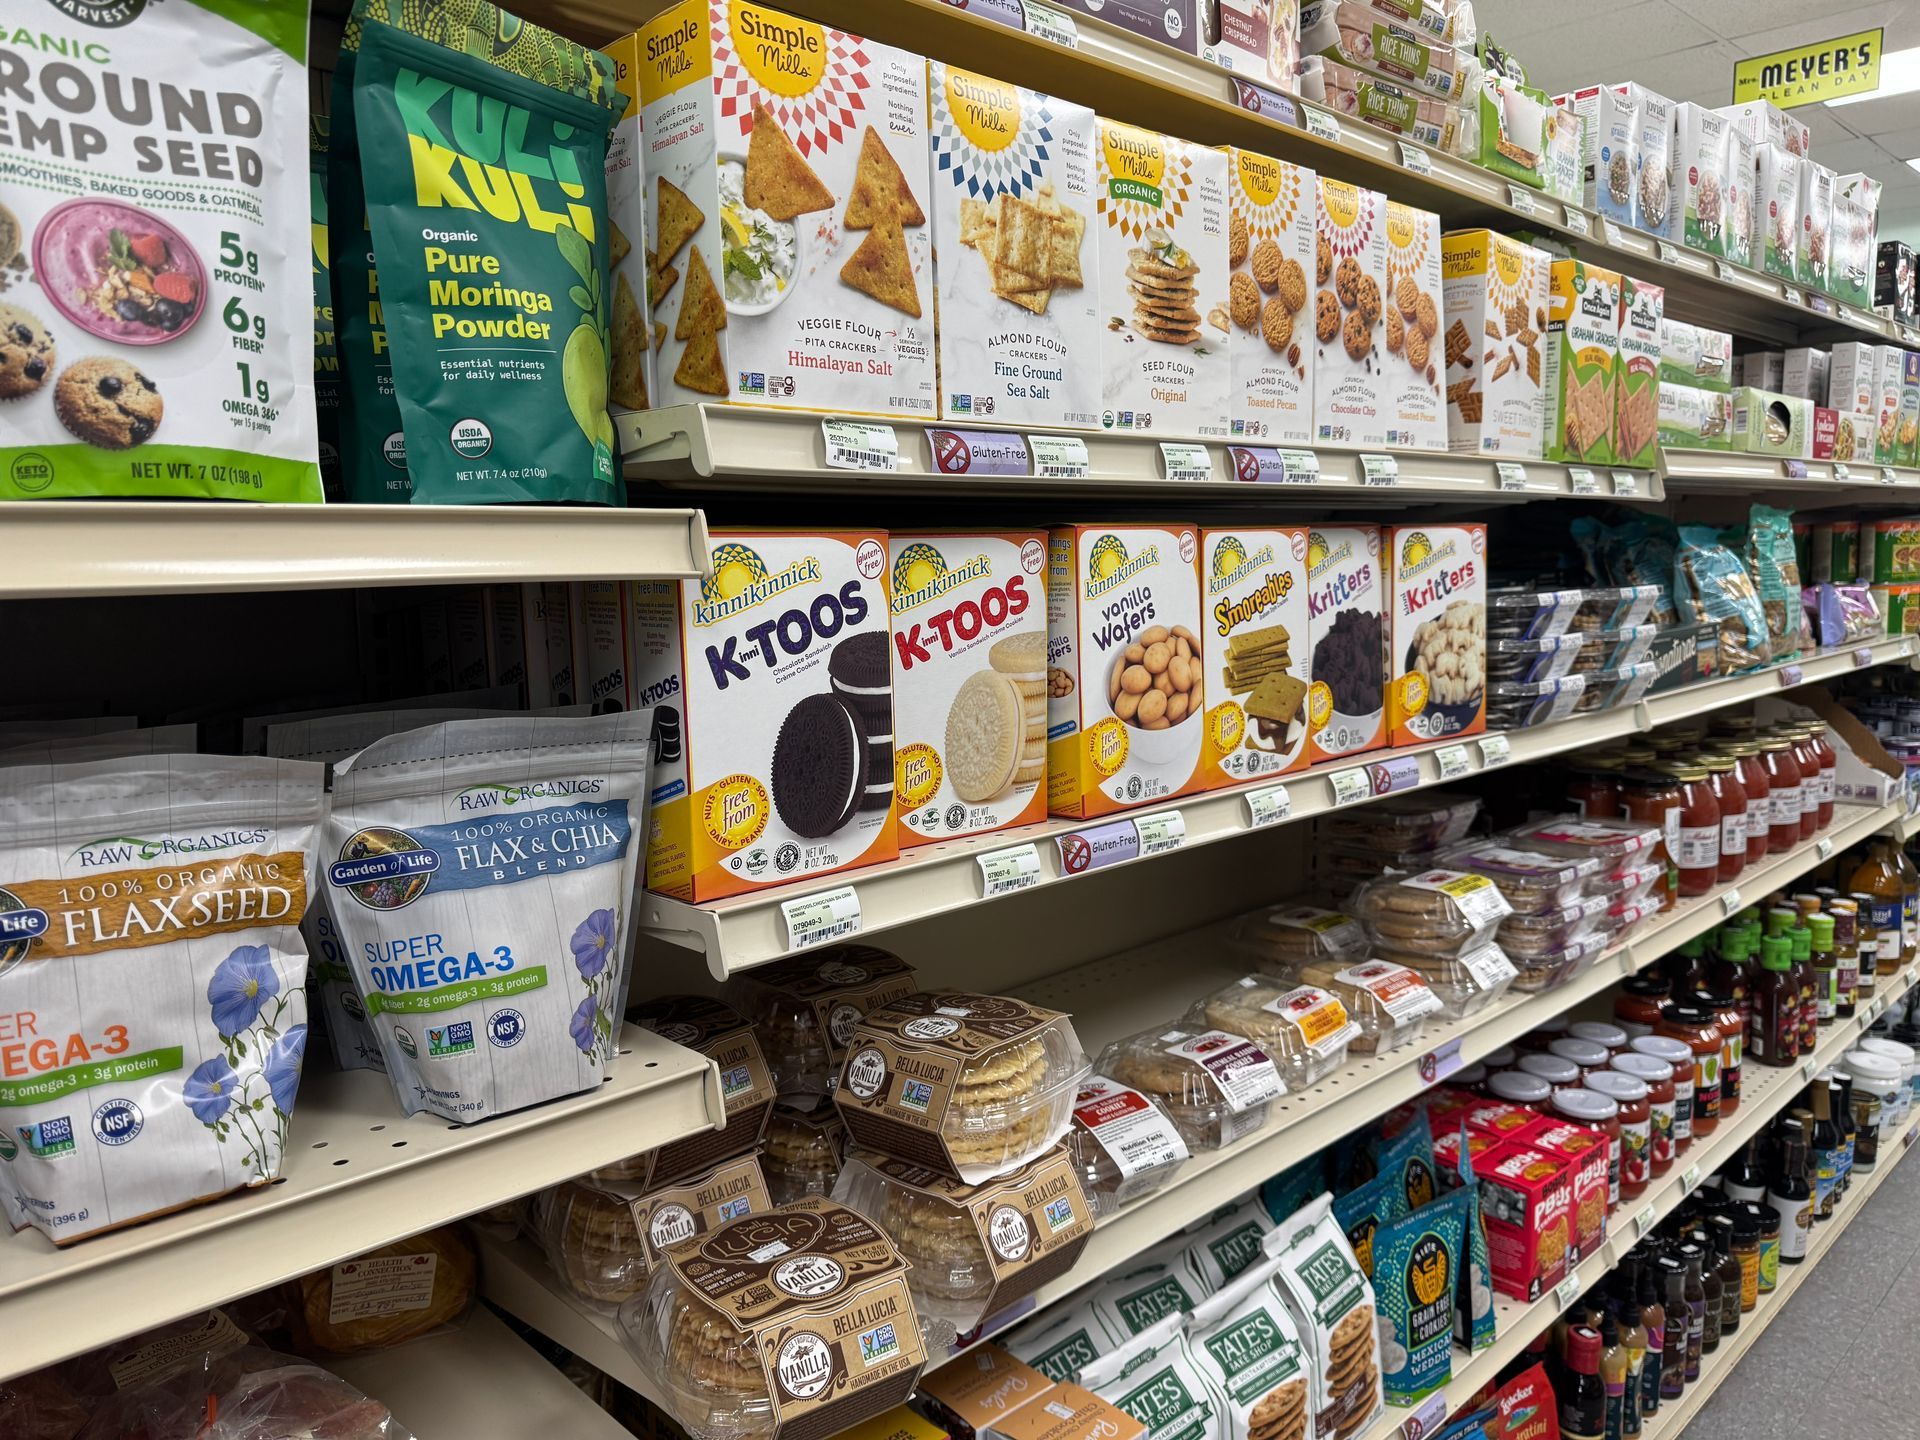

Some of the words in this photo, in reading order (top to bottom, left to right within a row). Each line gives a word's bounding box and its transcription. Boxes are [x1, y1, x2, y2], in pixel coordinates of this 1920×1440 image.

[50, 0, 132, 24] ARVEST
[1167, 14, 1180, 26] NO
[1223, 13, 1253, 33] CHESTNUT
[740, 10, 819, 54] Simple
[1224, 25, 1257, 48] CRISPBREAD
[756, 44, 812, 78] Mills
[890, 62, 907, 75] Only
[1760, 42, 1872, 89] MEYER'S
[882, 71, 917, 88] purposeful
[888, 100, 914, 114] Nothing
[1366, 89, 1382, 108] RICE
[1386, 96, 1409, 121] THINS
[1645, 98, 1666, 116] jovial
[1068, 128, 1080, 140] Only
[1701, 114, 1721, 135] jovial
[651, 130, 689, 153] Himalayan
[689, 122, 704, 138] Salt
[1108, 130, 1160, 160] Simple
[133, 136, 263, 188] SEED
[1066, 162, 1085, 175] Nothing
[1119, 154, 1155, 180] Mills
[1241, 156, 1277, 179] Simple
[1114, 183, 1158, 202] ORGANIC
[1325, 181, 1356, 202] Simple
[422, 228, 478, 243] Organic
[424, 247, 500, 276] Pure
[428, 280, 553, 314] Moringa
[432, 313, 552, 341] Powder
[798, 318, 843, 331] VEGGIE
[845, 319, 882, 341] FLOUR
[1571, 327, 1594, 342] GRAHAM
[805, 337, 826, 349] PITA
[829, 339, 877, 354] CRACKERS
[988, 333, 1032, 348] ALMOND
[1035, 335, 1067, 357] FLOUR
[440, 359, 493, 370] Essential
[499, 360, 545, 370] nutrients
[994, 362, 1019, 378] Fine
[1022, 364, 1063, 382] Ground
[442, 371, 460, 381] for
[466, 371, 495, 382] daily
[500, 371, 542, 381] wellness
[1150, 387, 1187, 404] Original
[1247, 396, 1275, 409] Toasted
[1276, 397, 1297, 411] Pecan
[1330, 403, 1362, 416] Chocolate
[1363, 405, 1377, 418] Chip
[971, 444, 1027, 461] Gluten-Free
[16, 464, 48, 476] KETO
[131, 462, 162, 479] NET
[168, 463, 194, 480] WT.
[199, 465, 206, 480] 7
[211, 465, 226, 481] OZ
[229, 465, 250, 486] (198
[252, 470, 263, 489] g)
[456, 470, 473, 482] NET
[475, 470, 492, 481] WT.
[493, 469, 507, 480] 7.4
[508, 470, 520, 479] oz
[521, 468, 547, 480] (210g)
[1027, 554, 1041, 572] free
[1086, 547, 1159, 598] kinnikinnick
[694, 557, 819, 626] kinnikinnick
[890, 556, 990, 613] kinnikinnick
[1405, 561, 1474, 614] Kritters
[1101, 586, 1152, 622] vanilla
[1214, 570, 1293, 637] S'moreables
[1092, 602, 1156, 651] Wafers
[772, 656, 805, 677] Chocolate
[805, 642, 832, 660] Sandwich
[640, 674, 680, 707] K-TOOS
[902, 743, 928, 756] GLUTEN
[904, 767, 931, 794] from
[722, 787, 750, 809] free
[451, 820, 512, 842] 100%
[520, 806, 609, 830] ORGANIC
[80, 844, 133, 867] RAW
[141, 829, 268, 862] ORGANICS
[455, 836, 530, 870] FLAX
[531, 837, 548, 853] &
[551, 822, 621, 853] CHIA
[805, 848, 817, 858] NET
[818, 845, 829, 856] WT
[1092, 834, 1137, 854] Gluten-Free
[494, 855, 586, 880] BLEND
[58, 877, 143, 905] 100%
[157, 863, 281, 891] ORGANIC
[2, 914, 39, 932] Life
[793, 916, 823, 931] 079049-3
[364, 933, 444, 964] SUPER
[450, 1023, 470, 1032] NON
[450, 1029, 471, 1039] GMO
[909, 1020, 950, 1035] VANILLA
[430, 1043, 474, 1055] VERIFIED
[895, 1055, 919, 1078] BELLA
[919, 1063, 945, 1083] LUCIA
[1207, 1054, 1235, 1070] OATMEAL
[850, 1064, 882, 1085] VANILLA
[1096, 1100, 1127, 1115] COOKIES
[42, 1118, 69, 1132] NON
[105, 1111, 131, 1132] NSF
[1120, 1138, 1147, 1152] Nutrition
[1147, 1133, 1163, 1142] Facts
[696, 1187, 724, 1207] BELLA
[725, 1176, 751, 1196] LUCIA
[52, 1212, 76, 1228] (396
[79, 1208, 89, 1222] g)
[651, 1221, 694, 1247] VANILLA
[368, 1258, 403, 1268] HEALTH
[1301, 1248, 1345, 1289] TATE'S
[1570, 1252, 1578, 1263] 4
[358, 1264, 413, 1278] CONNECTION
[780, 1262, 839, 1291] VANILLA
[1531, 1284, 1539, 1295] 4
[1122, 1282, 1183, 1324] TATE'S
[1412, 1308, 1436, 1328] GRAIN
[1435, 1295, 1450, 1314] FREE
[833, 1312, 866, 1337] BELLA
[867, 1296, 898, 1323] LUCIA
[876, 1325, 892, 1335] NON
[1211, 1315, 1275, 1364] TATE'S
[1230, 1355, 1250, 1373] BAKE
[1250, 1339, 1273, 1361] SHOP
[781, 1353, 829, 1382] VANILLA
[850, 1369, 881, 1390] HANDMADE
[882, 1367, 887, 1377] IN
[888, 1362, 899, 1374] THE
[900, 1357, 911, 1371] USA
[1158, 1402, 1181, 1424] SHOP
